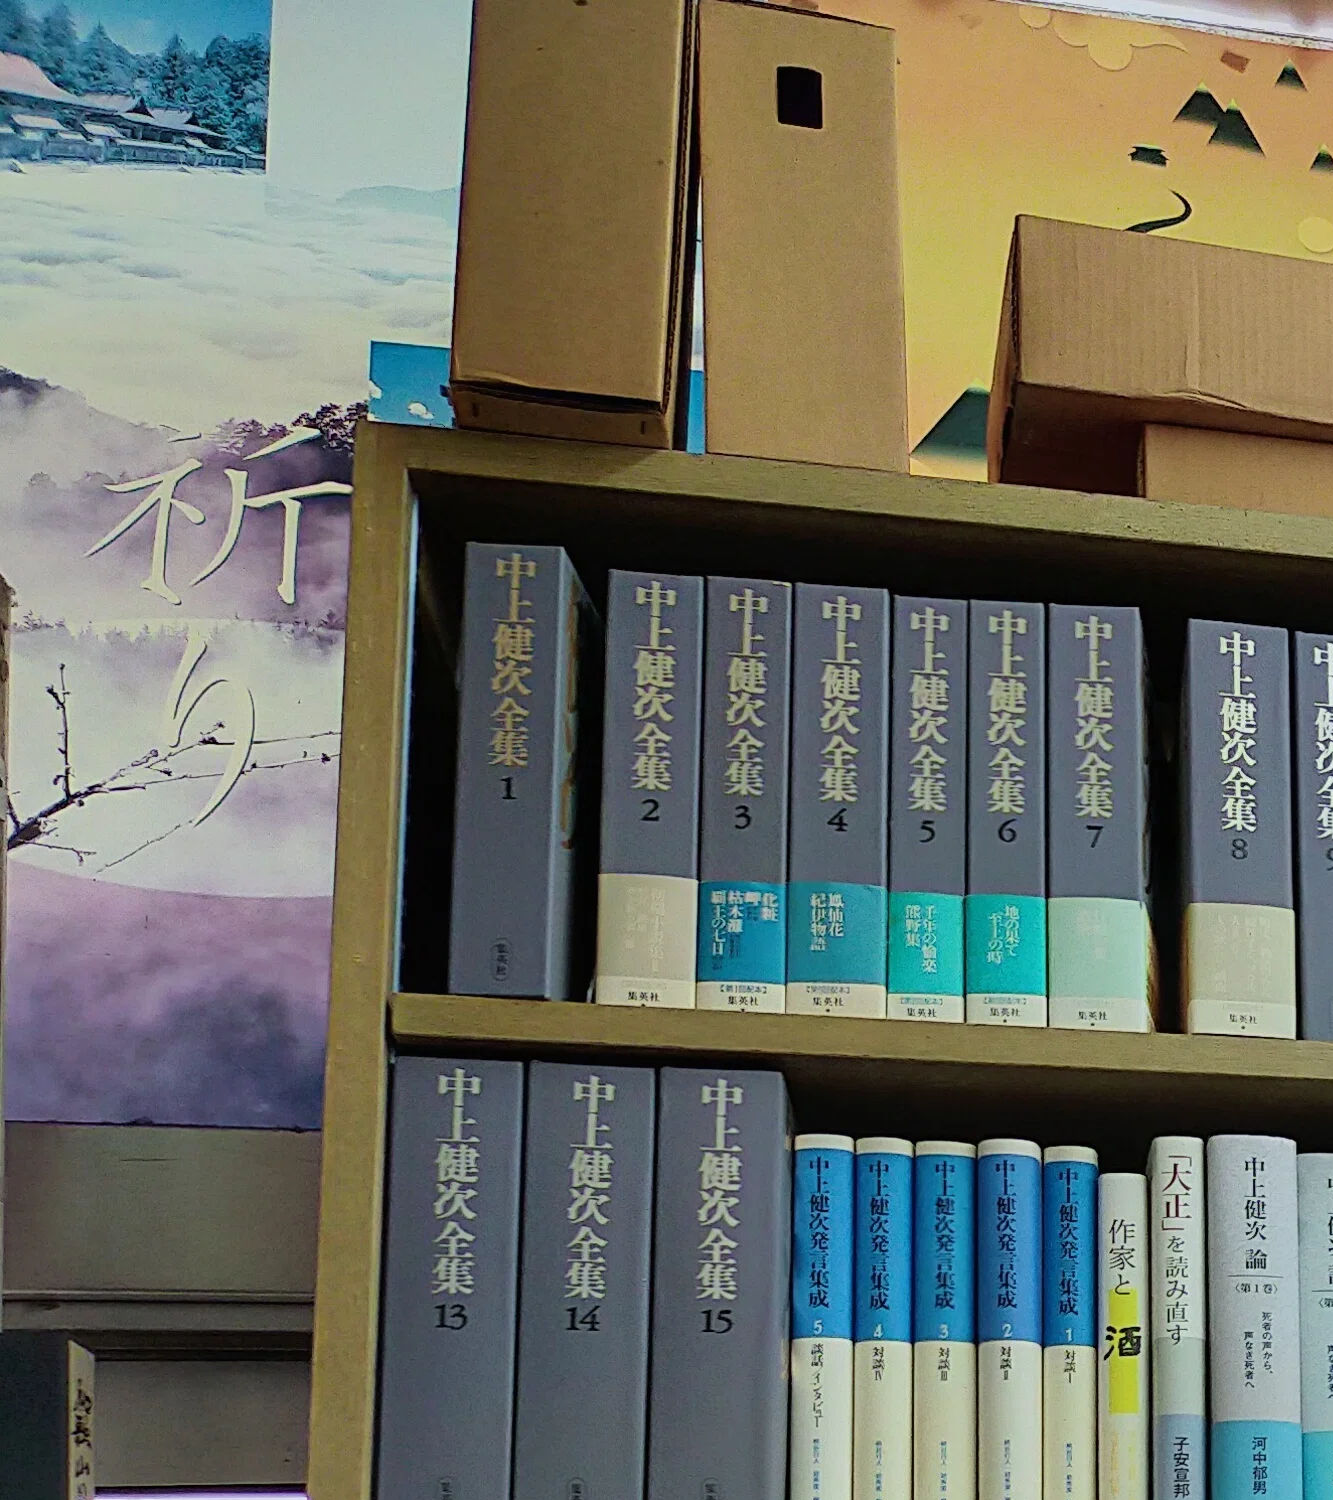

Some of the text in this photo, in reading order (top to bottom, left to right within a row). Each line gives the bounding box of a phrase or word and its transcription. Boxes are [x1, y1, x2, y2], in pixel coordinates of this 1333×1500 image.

[487, 553, 538, 769] 中上健次全集
[631, 581, 678, 792] 中上健次全集
[725, 588, 770, 830] 中上健次全集 3
[819, 595, 862, 833] 中上健次全集 4
[905, 606, 952, 844] 中上健次全集 5
[985, 609, 1029, 844] 中上健次全集 6
[1073, 615, 1115, 849] 中上健次全集 7
[1217, 631, 1258, 861] 中上健次全集 8
[431, 1066, 483, 1332] 中上健次全集 13
[564, 1075, 617, 1333] 中上健次全集 14
[695, 1078, 745, 1336] 中上健次全集 15
[1172, 1436, 1192, 1499] 子安宣邦
[1252, 1436, 1269, 1496] 河中郁男
